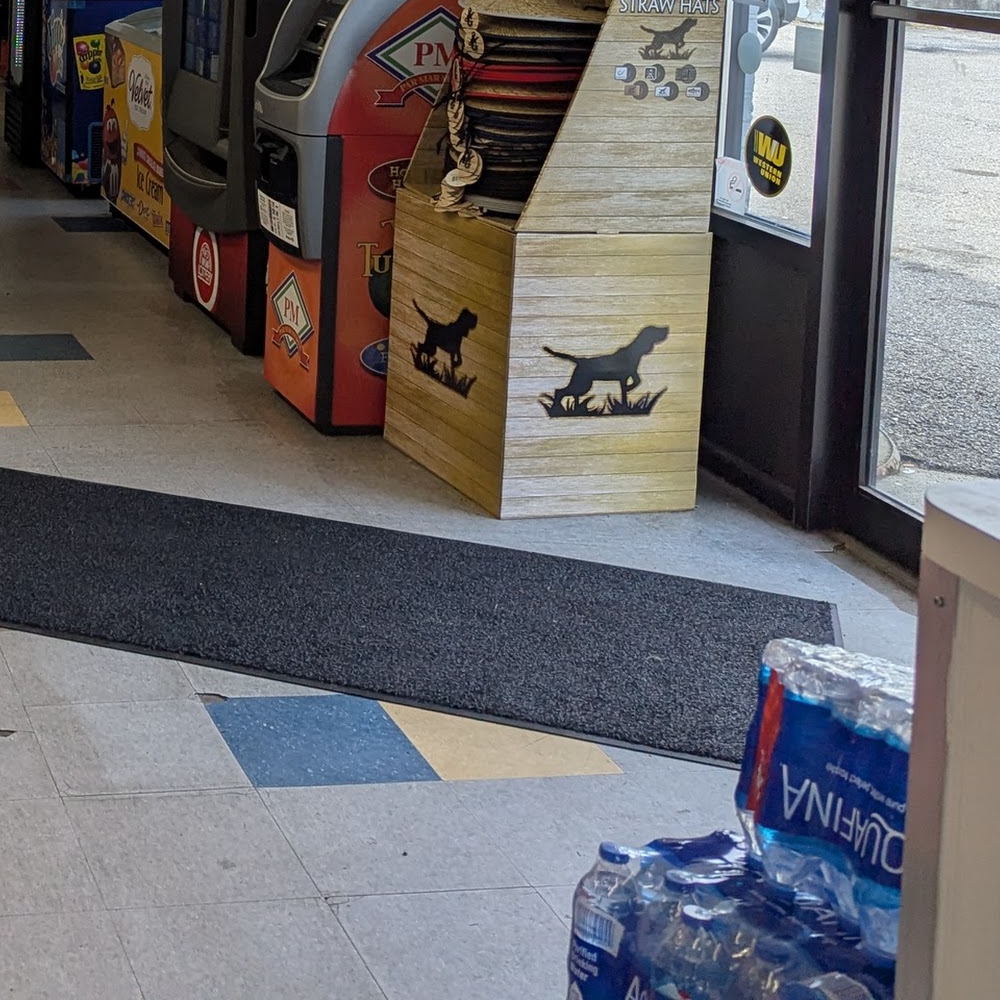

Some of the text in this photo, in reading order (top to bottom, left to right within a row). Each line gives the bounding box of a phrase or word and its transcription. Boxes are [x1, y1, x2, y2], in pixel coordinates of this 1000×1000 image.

[414, 42, 455, 67] PM
[129, 69, 154, 111] Velvet
[754, 129, 787, 167] WU
[753, 156, 782, 178] WESTERN
[761, 168, 781, 186] UNION
[136, 164, 145, 188] Ice
[145, 172, 164, 206] Cream
[284, 297, 300, 326] PM
[782, 764, 906, 874] QUAFINA
